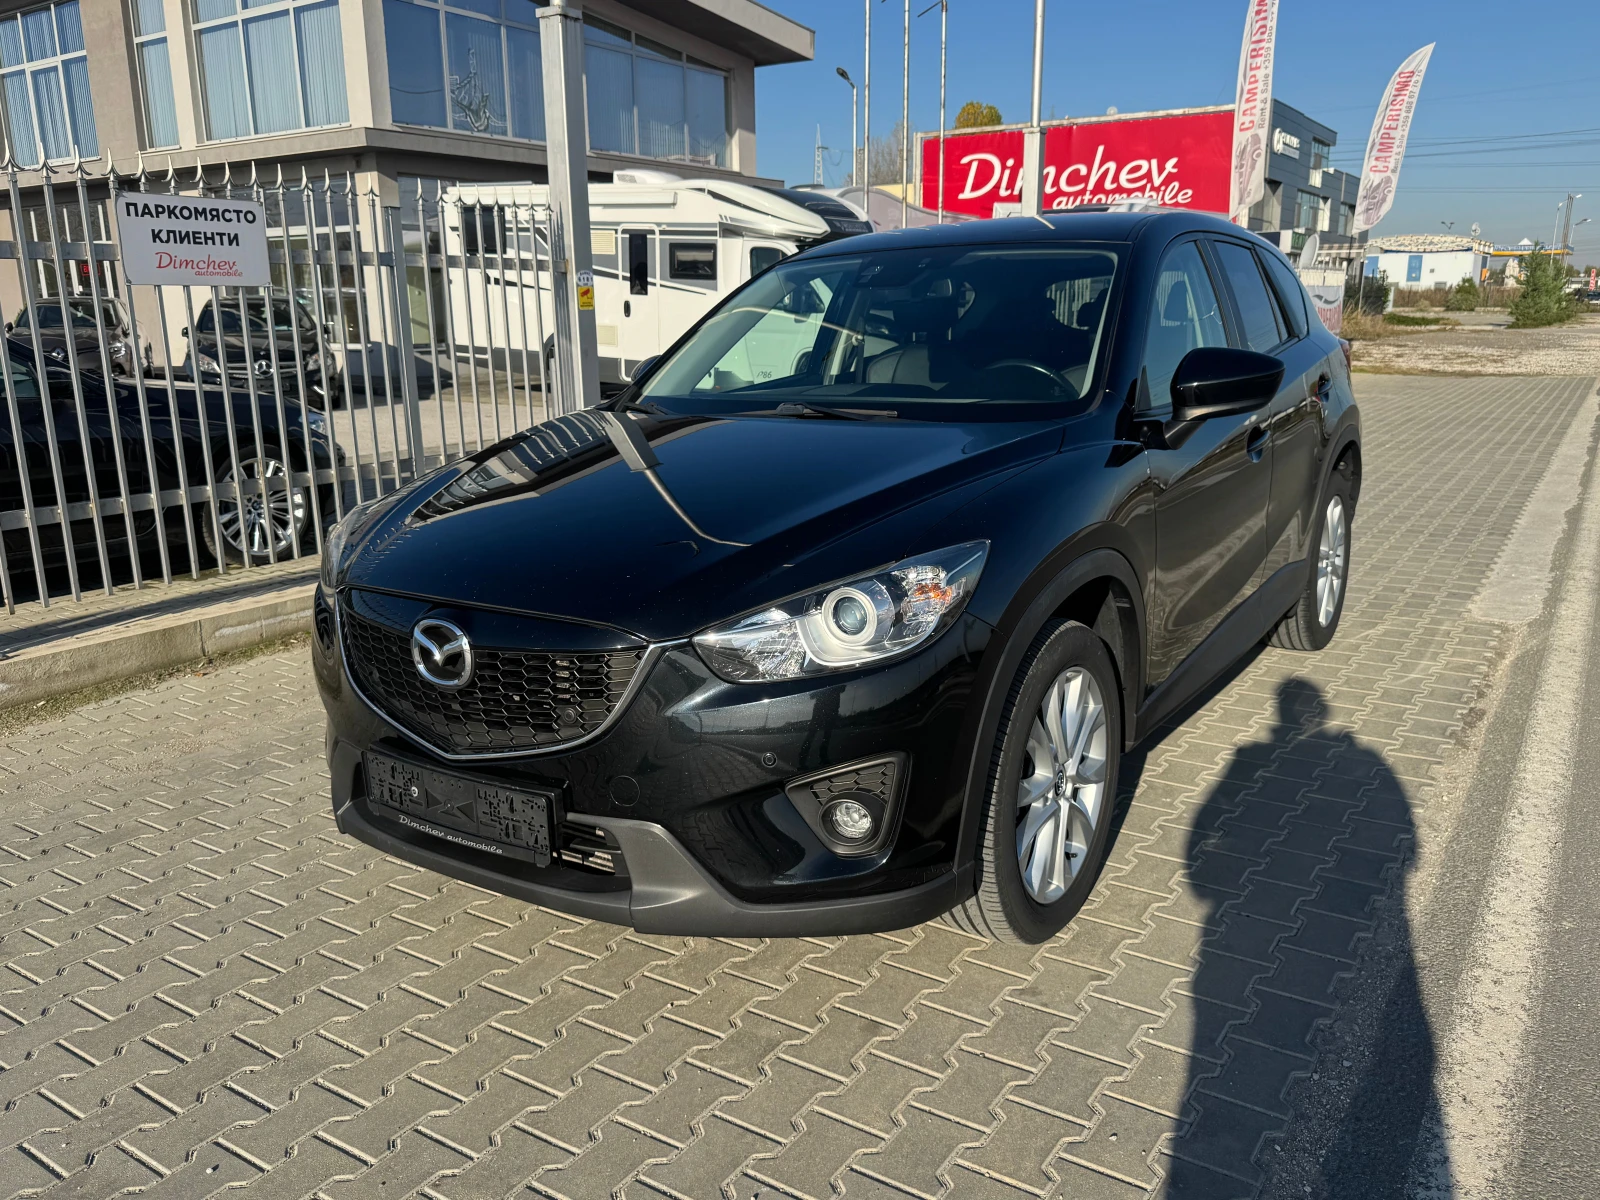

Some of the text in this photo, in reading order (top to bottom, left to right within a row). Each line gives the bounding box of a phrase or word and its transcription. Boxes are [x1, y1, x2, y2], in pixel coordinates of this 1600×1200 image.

[1263, 47, 1272, 70] +359
[1261, 73, 1270, 93] Sale
[1258, 107, 1267, 129] Rent
[1370, 70, 1416, 173] CAMPERISIMO
[125, 202, 257, 224] ПАРКОМЯСТО
[151, 229, 240, 247] КЛИЕНТИ
[155, 251, 237, 271] Dimchev
[194, 268, 243, 277] automobile
[398, 814, 503, 854] Dimchev automobile
